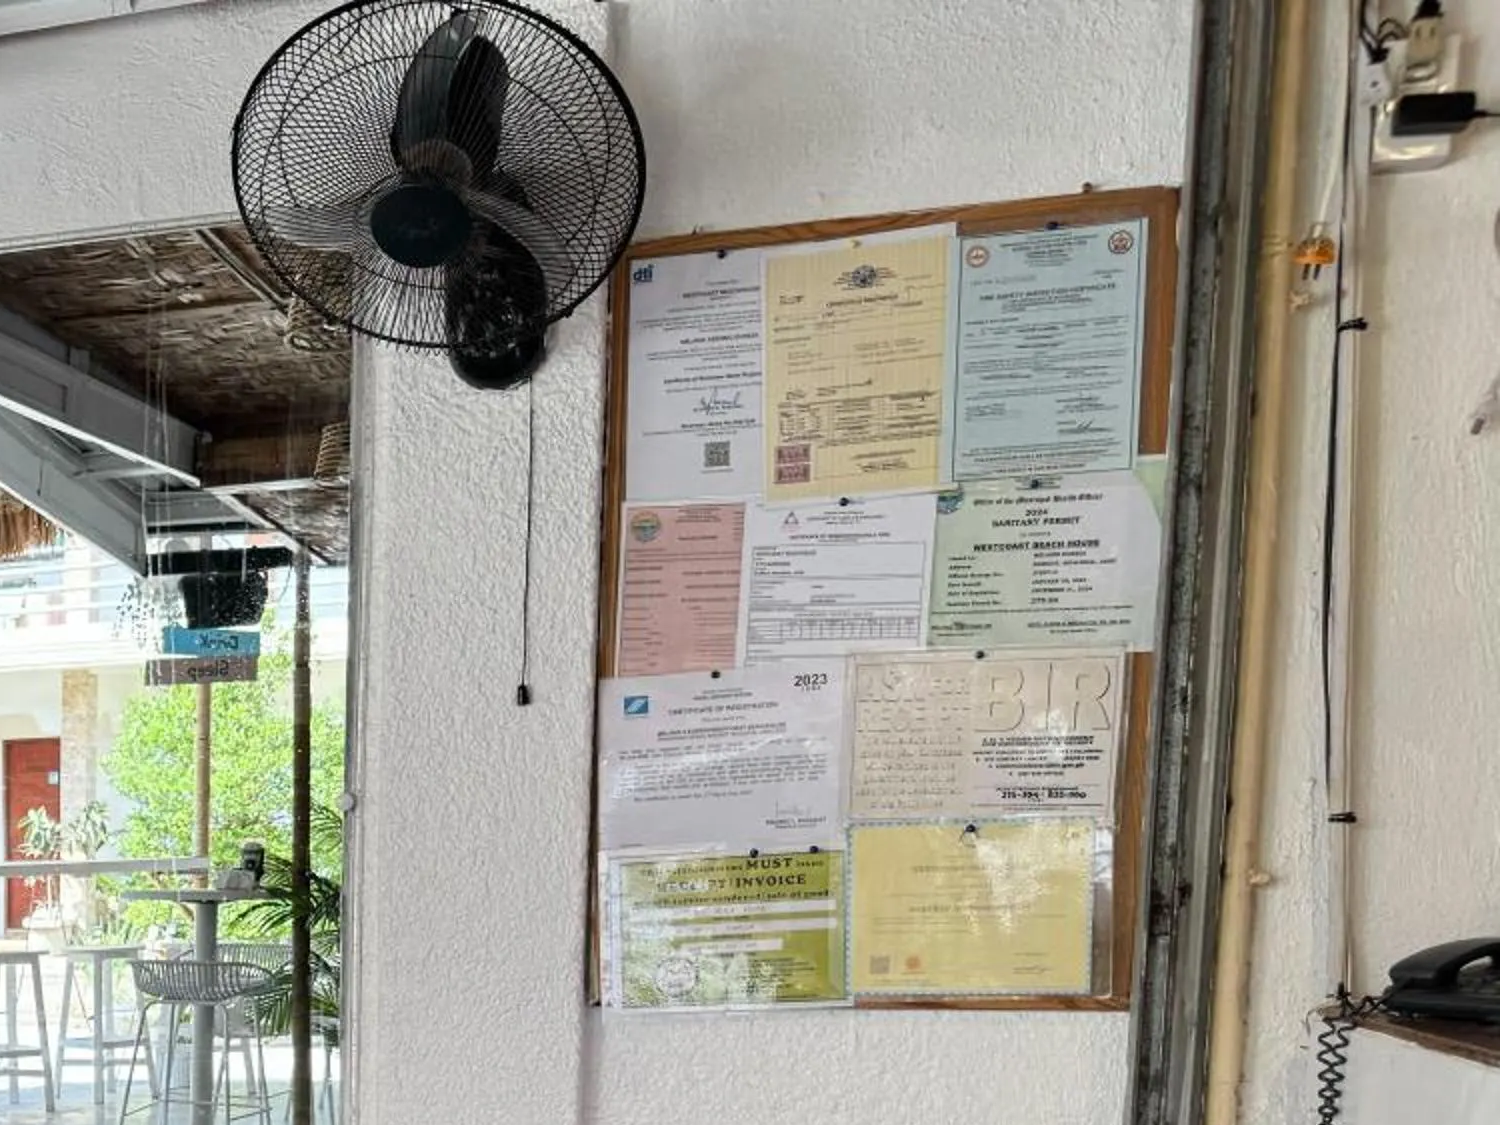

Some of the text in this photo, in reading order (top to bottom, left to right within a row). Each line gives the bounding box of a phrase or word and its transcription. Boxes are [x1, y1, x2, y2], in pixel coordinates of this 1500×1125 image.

[633, 264, 654, 282] dti
[992, 516, 1081, 528] SANITARY PERMIT
[793, 673, 828, 688] 2023
[974, 660, 1112, 732] BIR
[745, 857, 793, 871] MUST
[735, 874, 806, 889] INVOICE
